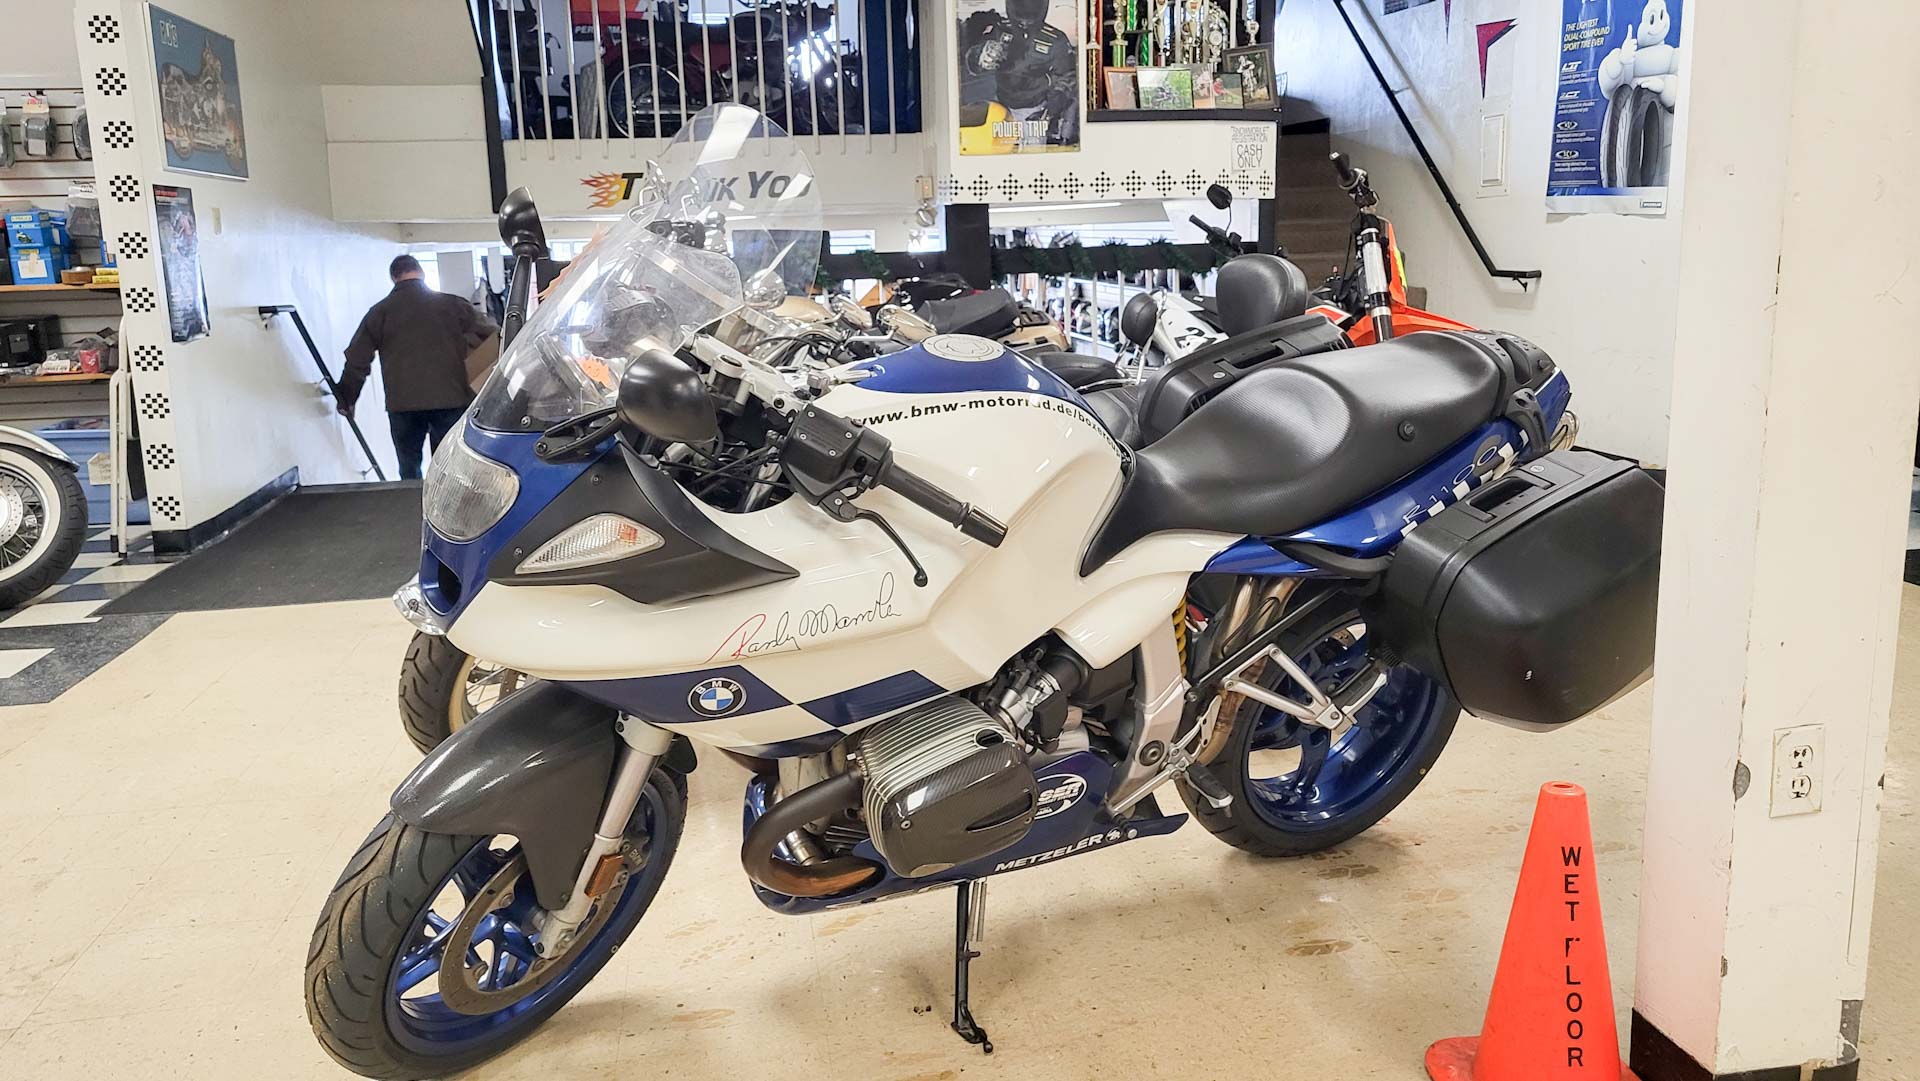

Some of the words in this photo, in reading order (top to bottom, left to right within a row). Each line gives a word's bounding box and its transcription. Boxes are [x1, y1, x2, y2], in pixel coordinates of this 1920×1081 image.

[992, 120, 1024, 138] POWER
[1027, 120, 1048, 137] TRIP
[1237, 144, 1262, 157] CASH
[1237, 156, 1262, 168] ONLY
[1429, 446, 1497, 503] 1100
[695, 680, 740, 695] BMW
[994, 833, 1104, 872] METZELER
[1561, 846, 1582, 922] WET
